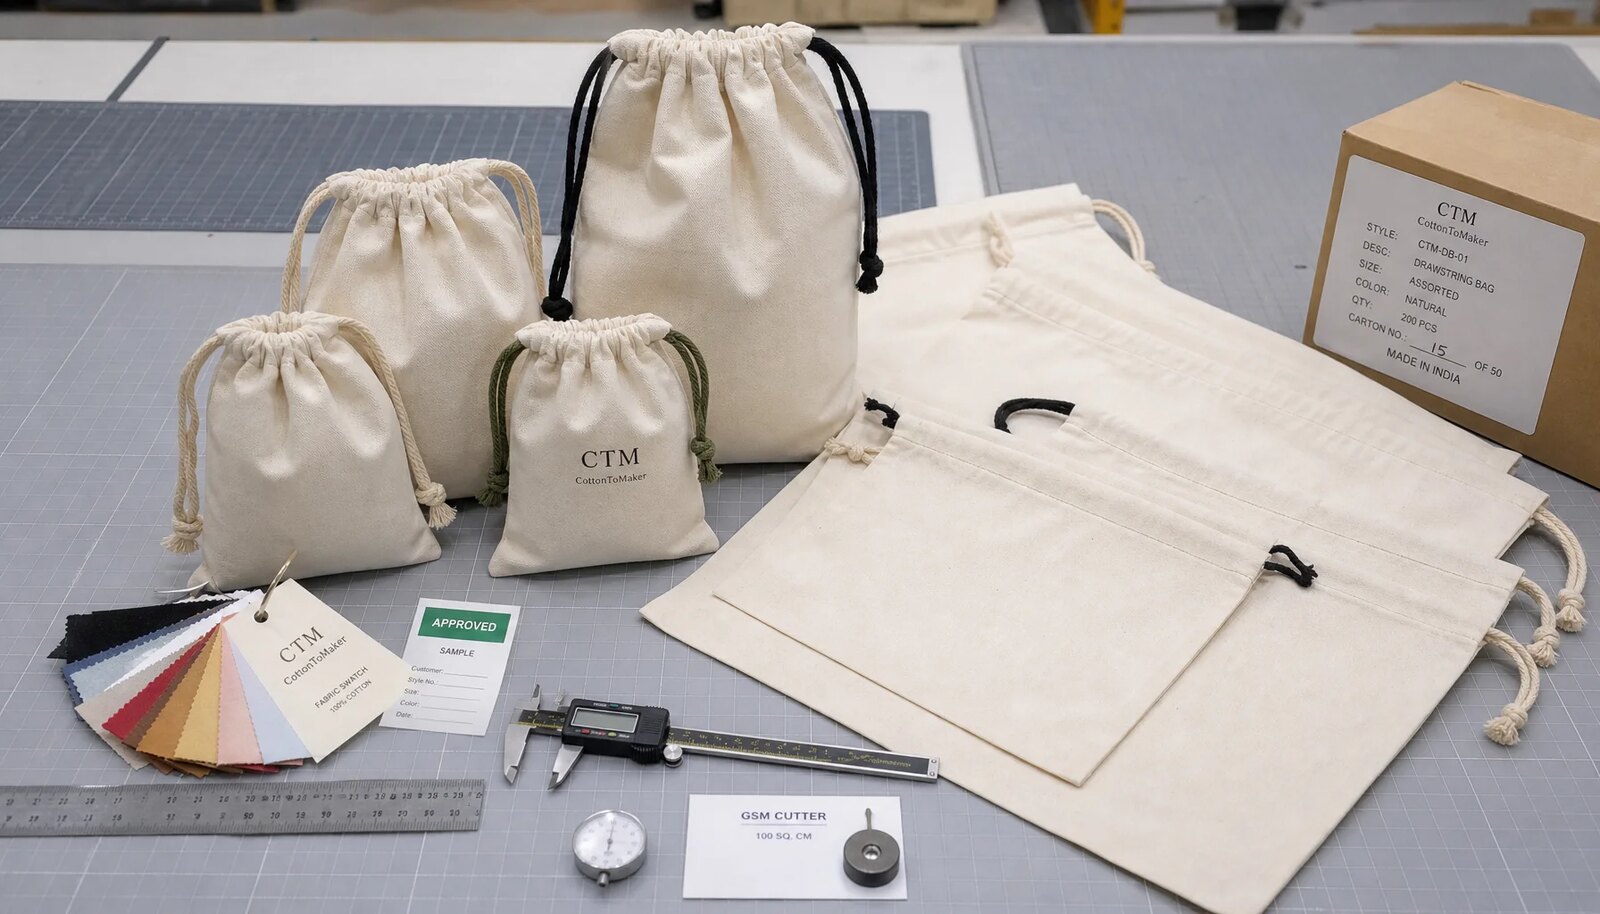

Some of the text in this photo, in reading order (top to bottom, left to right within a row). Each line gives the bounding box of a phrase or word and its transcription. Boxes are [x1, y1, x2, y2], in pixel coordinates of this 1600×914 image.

[1437, 201, 1478, 226] CTM
[1366, 222, 1469, 264] STYLE: CTM-DB-01
[1417, 216, 1489, 247] CottonToMaker
[1359, 258, 1460, 301] SIZE: ASSORTED
[1362, 240, 1495, 294] DESC: DRAWSTRING BAG
[1355, 277, 1448, 318] COLOR: NATURAL
[1348, 312, 1408, 342] CARTON NO.:
[1351, 295, 1438, 334] QTY: 200 PCS
[1431, 342, 1448, 357] 15
[1386, 347, 1461, 385] MADE IN INDIA
[1474, 361, 1503, 379] OF 50
[581, 447, 640, 469] CTM
[575, 473, 647, 485] CottonToMaker
[431, 618, 497, 632] APPROVED
[279, 626, 324, 663] CTM
[439, 647, 475, 658] SAMPLE
[283, 636, 347, 686] CottonToMaker
[411, 665, 444, 674] Customer:
[314, 666, 369, 709] FABRIC SWATCH
[407, 676, 424, 686] Style
[329, 679, 372, 713] 100% COTTON
[395, 711, 413, 719] Date:
[741, 811, 827, 821] GSM CUTTER
[756, 832, 773, 840] 100
[795, 832, 812, 840] CM
